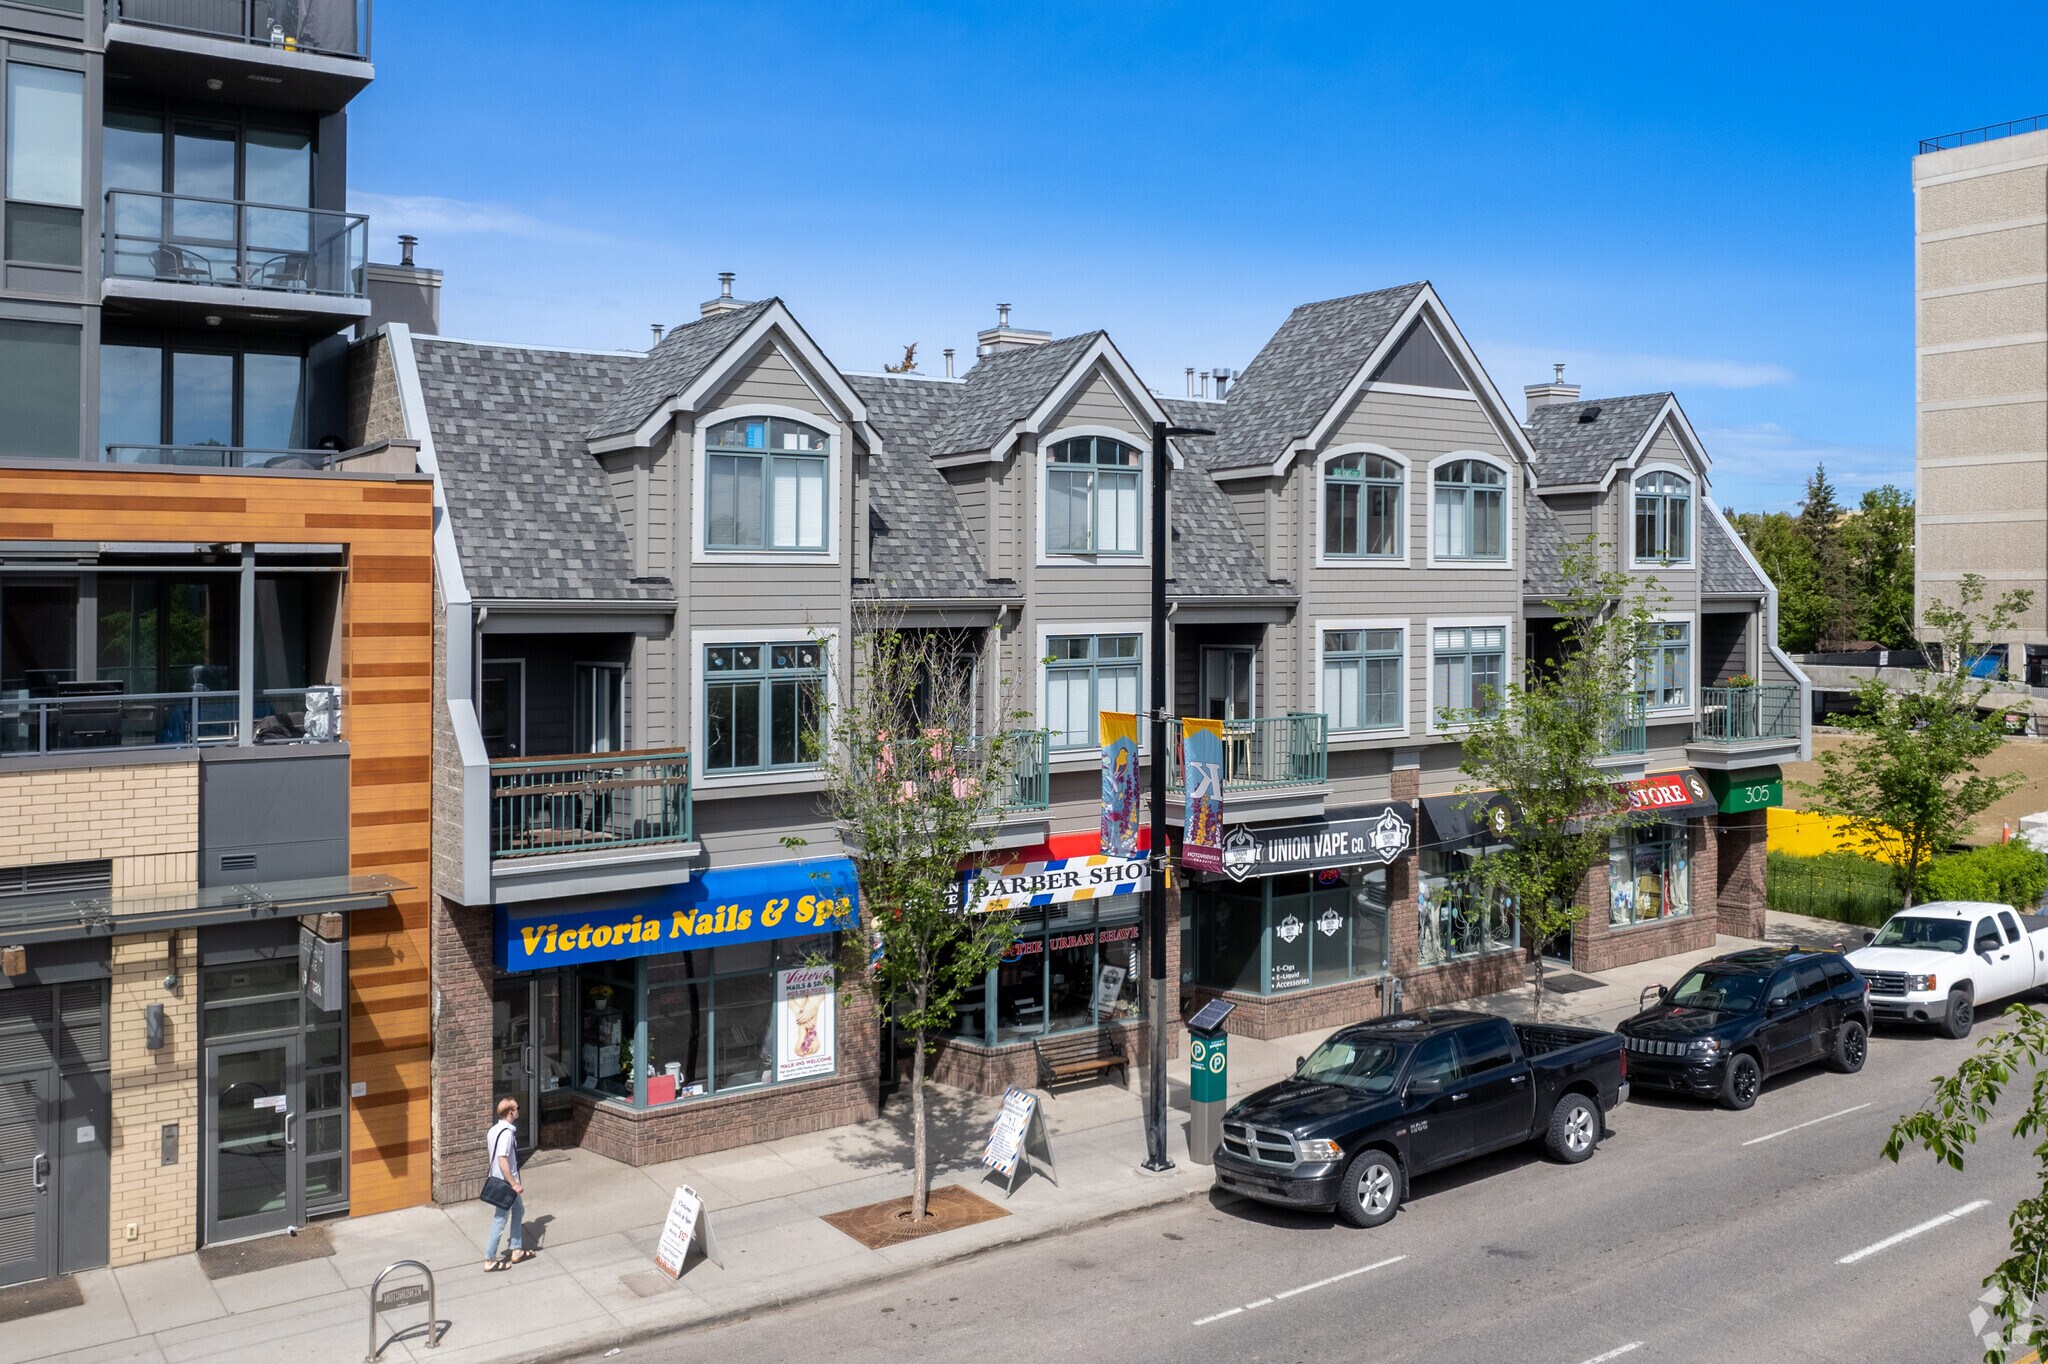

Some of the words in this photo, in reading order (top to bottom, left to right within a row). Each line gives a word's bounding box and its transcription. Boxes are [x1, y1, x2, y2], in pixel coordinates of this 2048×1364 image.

[1628, 784, 1687, 807] STORE
[1744, 784, 1770, 804] 305
[1269, 835, 1310, 863] UNION
[1313, 831, 1349, 858] VAPE
[1351, 837, 1367, 854] CO.
[521, 914, 661, 956] Victoria
[669, 904, 753, 938] Nails
[760, 898, 790, 928] &
[795, 895, 850, 927] Spa
[1015, 940, 1043, 955] THE
[1049, 933, 1095, 951] URBAN
[1099, 927, 1139, 943] SHAVE
[1276, 964, 1295, 972] E-Cigs
[1276, 971, 1300, 980] E-Liquid
[786, 982, 806, 991] NAILS
[1276, 977, 1310, 988] Accessories
[780, 1060, 805, 1069] WALK-INS
[806, 1056, 832, 1065] WELCOME
